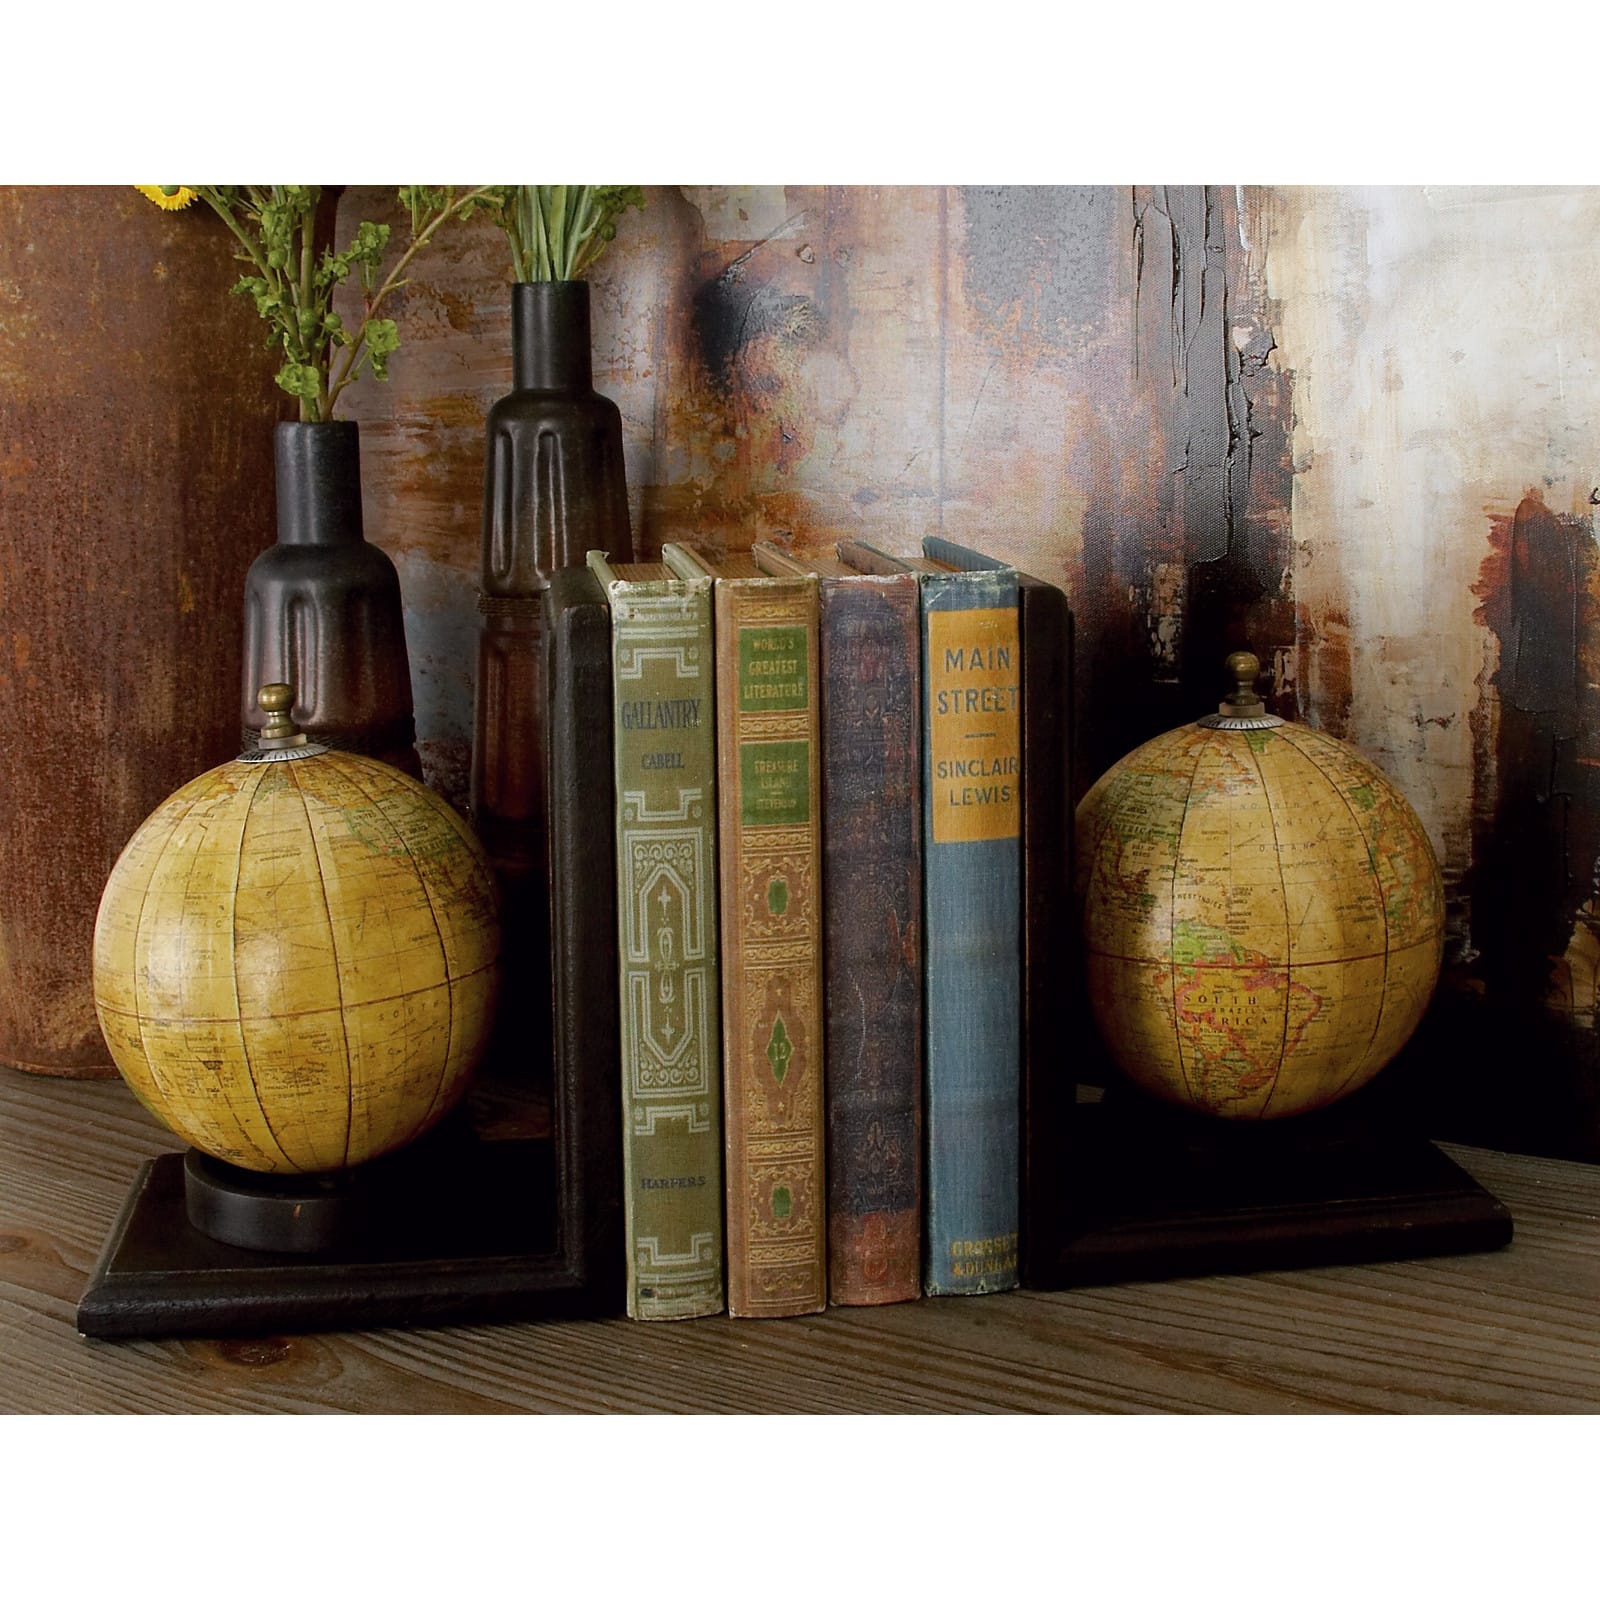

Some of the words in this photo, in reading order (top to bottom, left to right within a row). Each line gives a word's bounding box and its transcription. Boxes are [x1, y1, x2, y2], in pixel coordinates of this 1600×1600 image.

[748, 660, 798, 677] GREATEST
[944, 647, 1010, 673] MAIN
[743, 681, 804, 700] LITERATURE
[937, 686, 1019, 715] STREET
[621, 698, 701, 730] GALLANTRY
[641, 753, 685, 769] CABELL
[936, 756, 1020, 780] SINCLAIR
[949, 785, 1011, 807] LEWIS
[640, 1175, 706, 1190] HARPERS
